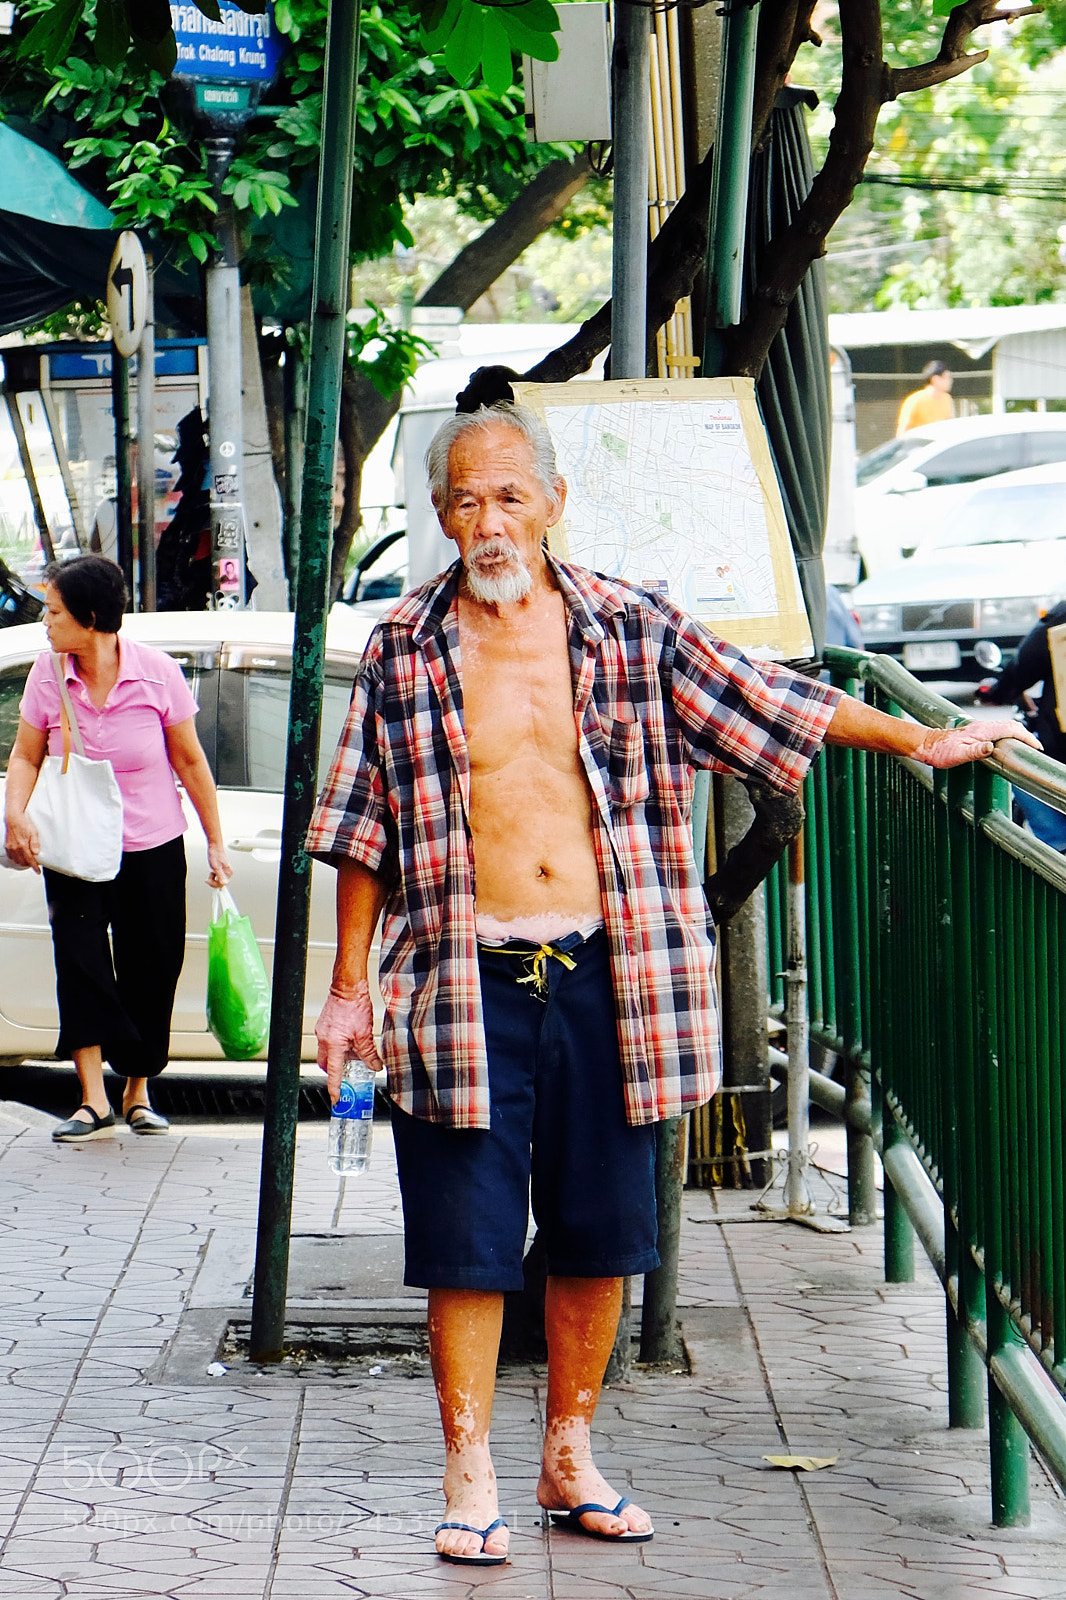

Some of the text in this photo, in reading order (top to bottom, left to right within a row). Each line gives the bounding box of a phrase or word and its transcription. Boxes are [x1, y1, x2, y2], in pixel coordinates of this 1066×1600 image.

[175, 41, 267, 70] Trok Chalong Krung
